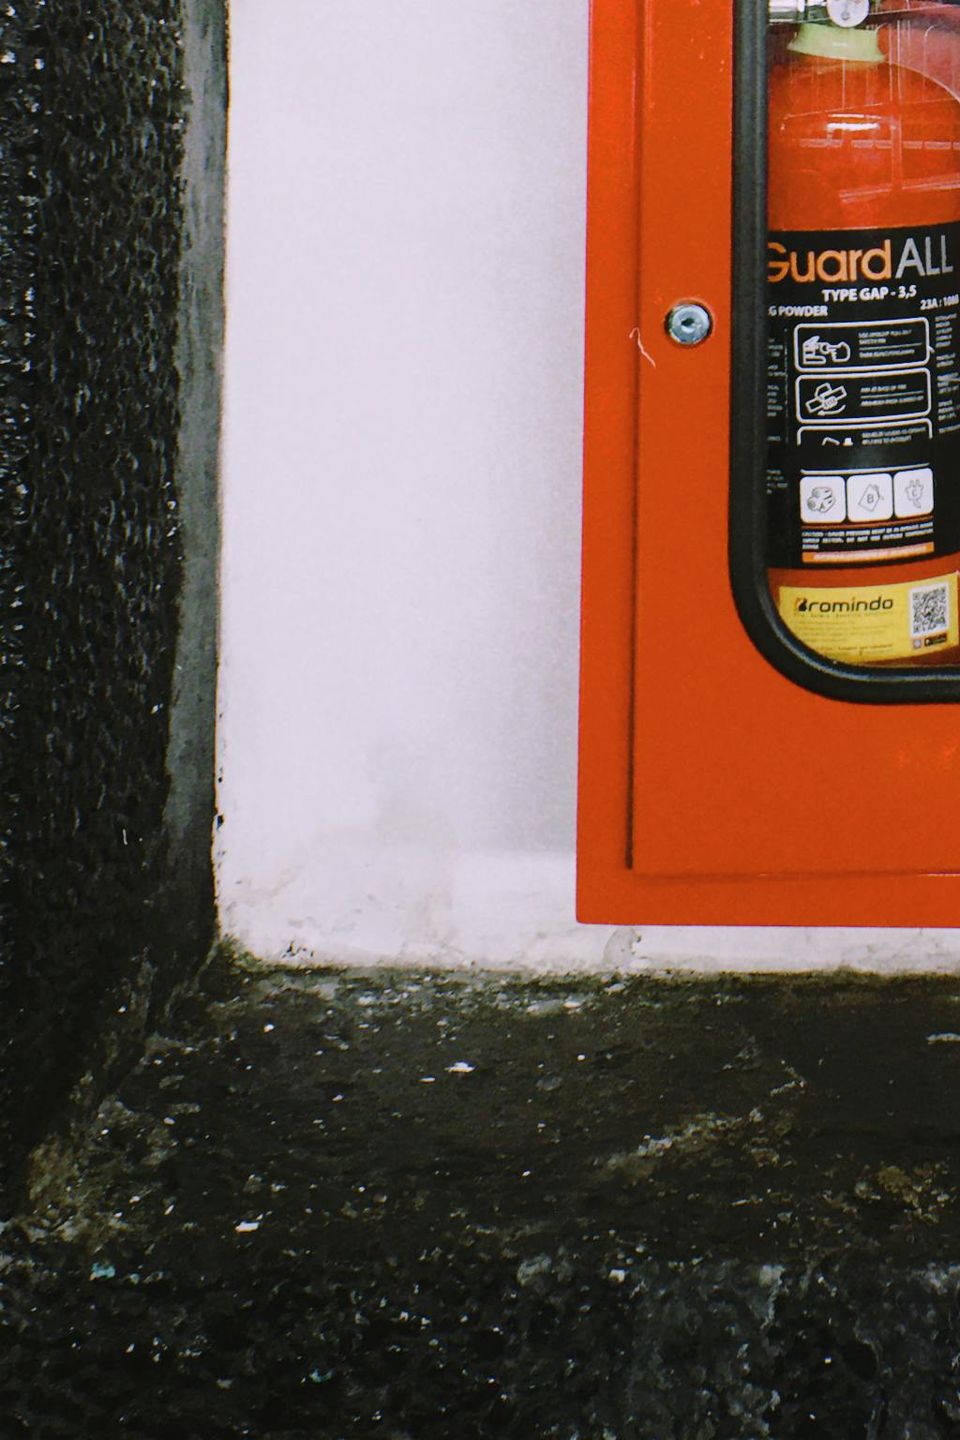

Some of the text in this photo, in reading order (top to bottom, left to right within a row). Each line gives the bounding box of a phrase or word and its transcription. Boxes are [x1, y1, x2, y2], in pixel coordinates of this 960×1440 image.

[822, 288, 859, 302] TYPE
[859, 286, 889, 301] GAP
[778, 305, 828, 317] POWDER
